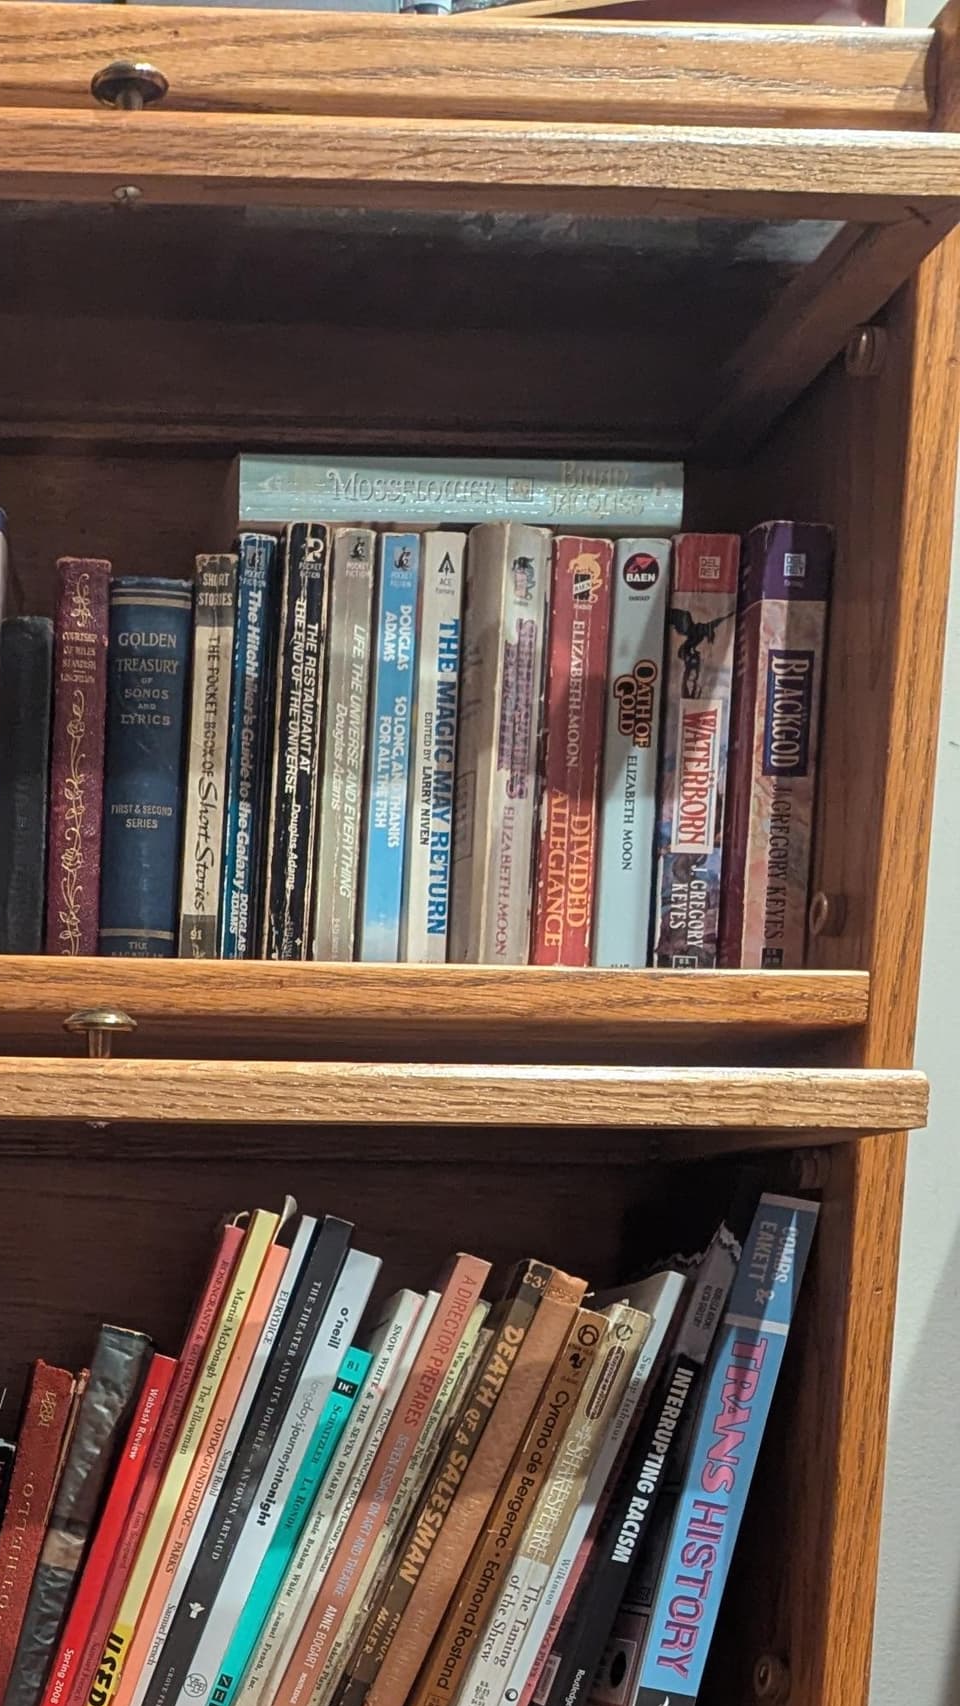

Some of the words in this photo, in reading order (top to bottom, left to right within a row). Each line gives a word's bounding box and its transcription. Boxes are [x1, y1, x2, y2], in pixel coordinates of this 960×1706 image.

[115, 660, 179, 677] TREASURY
[118, 632, 178, 650] GOLDEN
[436, 618, 460, 676] THE
[433, 680, 458, 766] MAGIC
[771, 657, 810, 769] BLACKGOD
[431, 770, 455, 823] MAY
[624, 755, 639, 826] ELIZABETH
[426, 828, 453, 936] RETURN
[544, 790, 568, 947] ALLEGIANCE
[566, 813, 591, 929] DIVIDED
[621, 829, 635, 871] MOON
[326, 1306, 351, 1350] o'neill
[144, 1387, 160, 1422] Wabash
[535, 1389, 570, 1450] Cyrano
[637, 1366, 695, 1492] INTERRUPTING
[698, 1336, 769, 1496] TRANS
[127, 1424, 148, 1461] Review
[525, 1453, 542, 1475] de
[494, 1475, 534, 1550] Bergerac
[610, 1496, 649, 1564] RACISM
[468, 1561, 499, 1619] Edmond
[657, 1498, 729, 1680] HISTORY
[436, 1622, 473, 1691] Rostand
